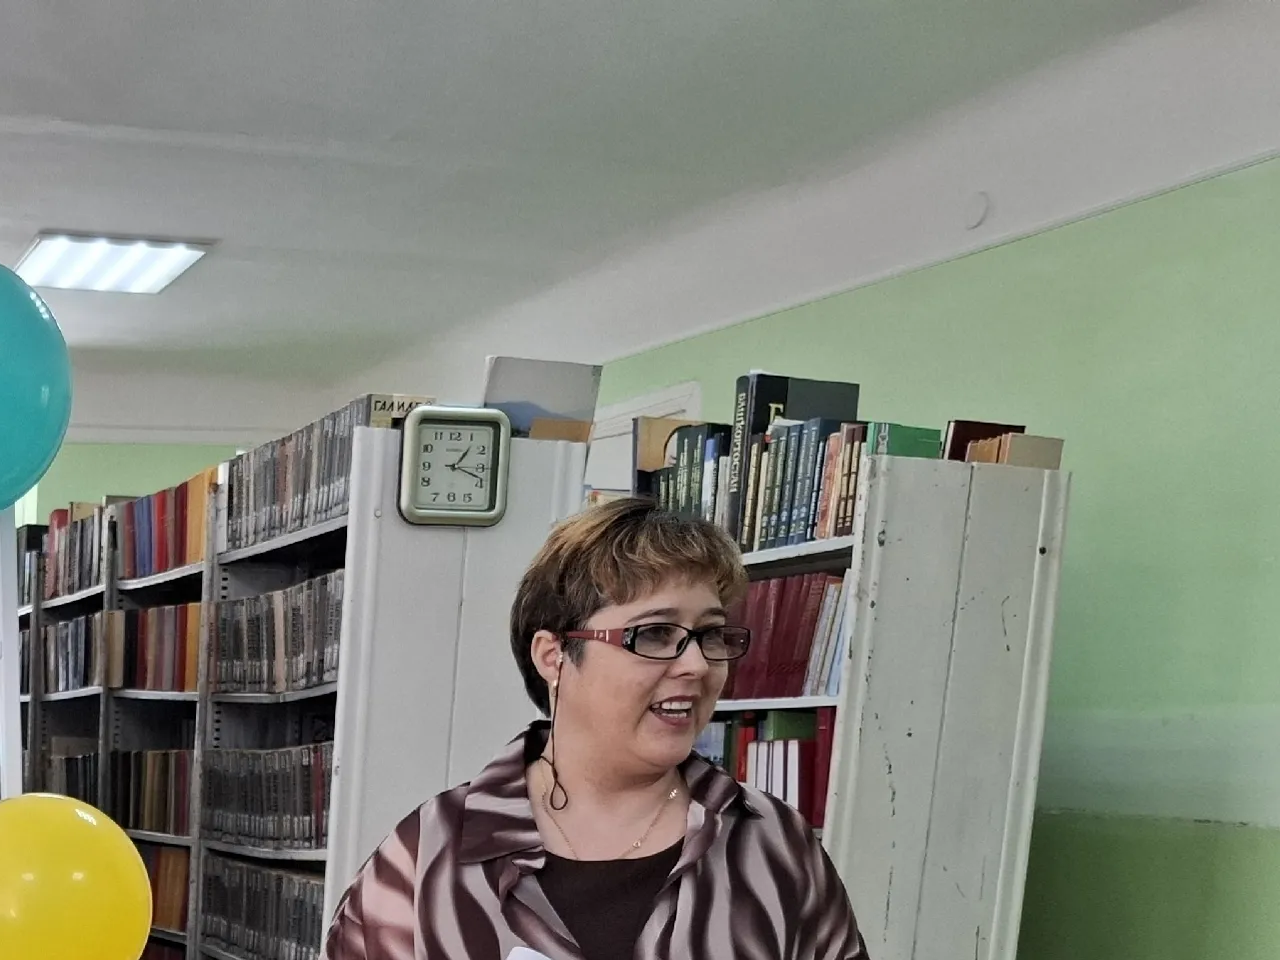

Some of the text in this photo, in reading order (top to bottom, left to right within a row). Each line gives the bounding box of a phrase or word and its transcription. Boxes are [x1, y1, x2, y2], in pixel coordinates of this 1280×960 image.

[449, 432, 462, 441] 12
[422, 444, 433, 453] 10
[476, 445, 486, 455] 2
[422, 462, 431, 471] 9
[421, 477, 431, 487] 8
[431, 492, 473, 503] 7 6 5
